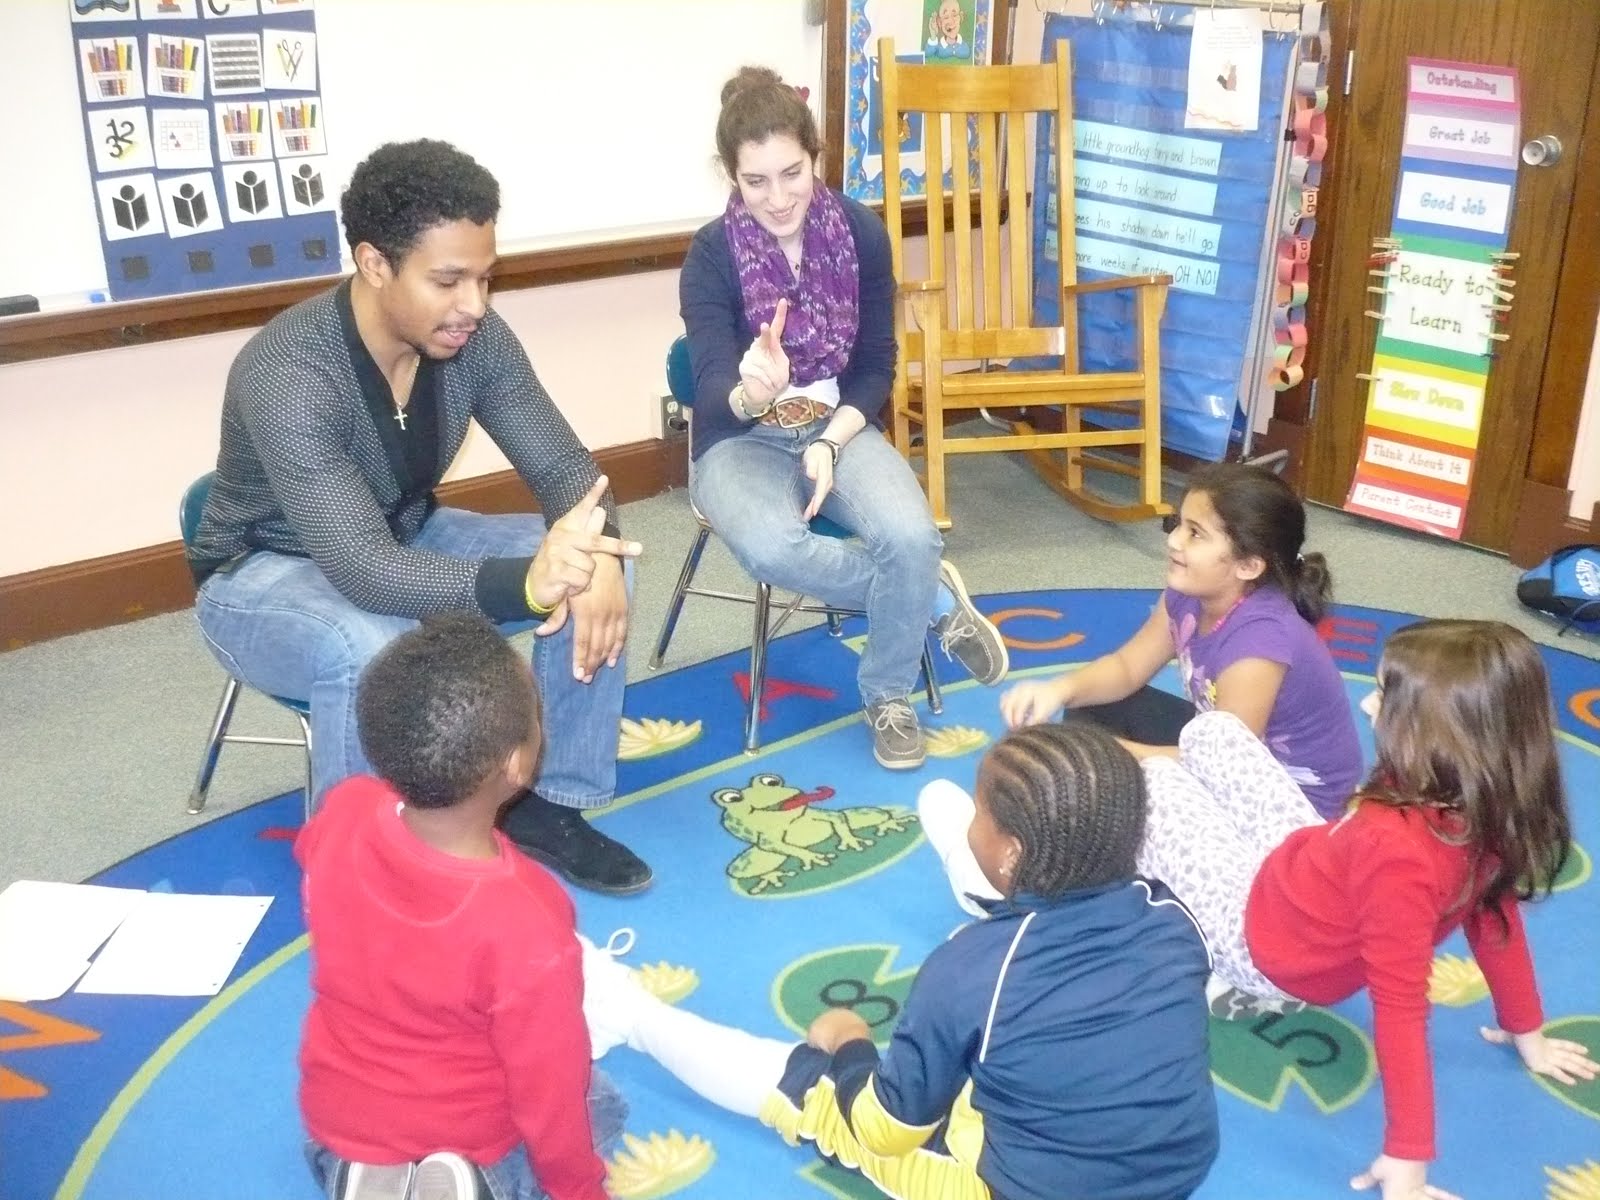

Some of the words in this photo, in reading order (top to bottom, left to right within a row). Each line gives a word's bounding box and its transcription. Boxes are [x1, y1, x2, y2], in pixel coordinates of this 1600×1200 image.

[1082, 131, 1103, 150] little
[1190, 146, 1217, 168] brown
[1429, 126, 1465, 141] Great
[1471, 130, 1491, 145] Job
[1096, 179, 1108, 193] up
[1116, 175, 1128, 193] to
[1134, 178, 1149, 198] look
[1420, 192, 1456, 211] Good
[1462, 197, 1487, 216] Job
[1075, 213, 1090, 226] ees
[1096, 210, 1112, 229] his
[1200, 238, 1214, 254] go
[1100, 255, 1126, 270] weeks
[1174, 264, 1191, 285] OH
[1196, 268, 1217, 286] NO!
[1399, 263, 1454, 295] Ready
[1465, 275, 1484, 296] to
[1410, 306, 1462, 333] Learn
[1373, 443, 1404, 462] Think
[1408, 451, 1444, 471] About
[1361, 487, 1401, 506] Parent
[1406, 498, 1453, 519] Contact
